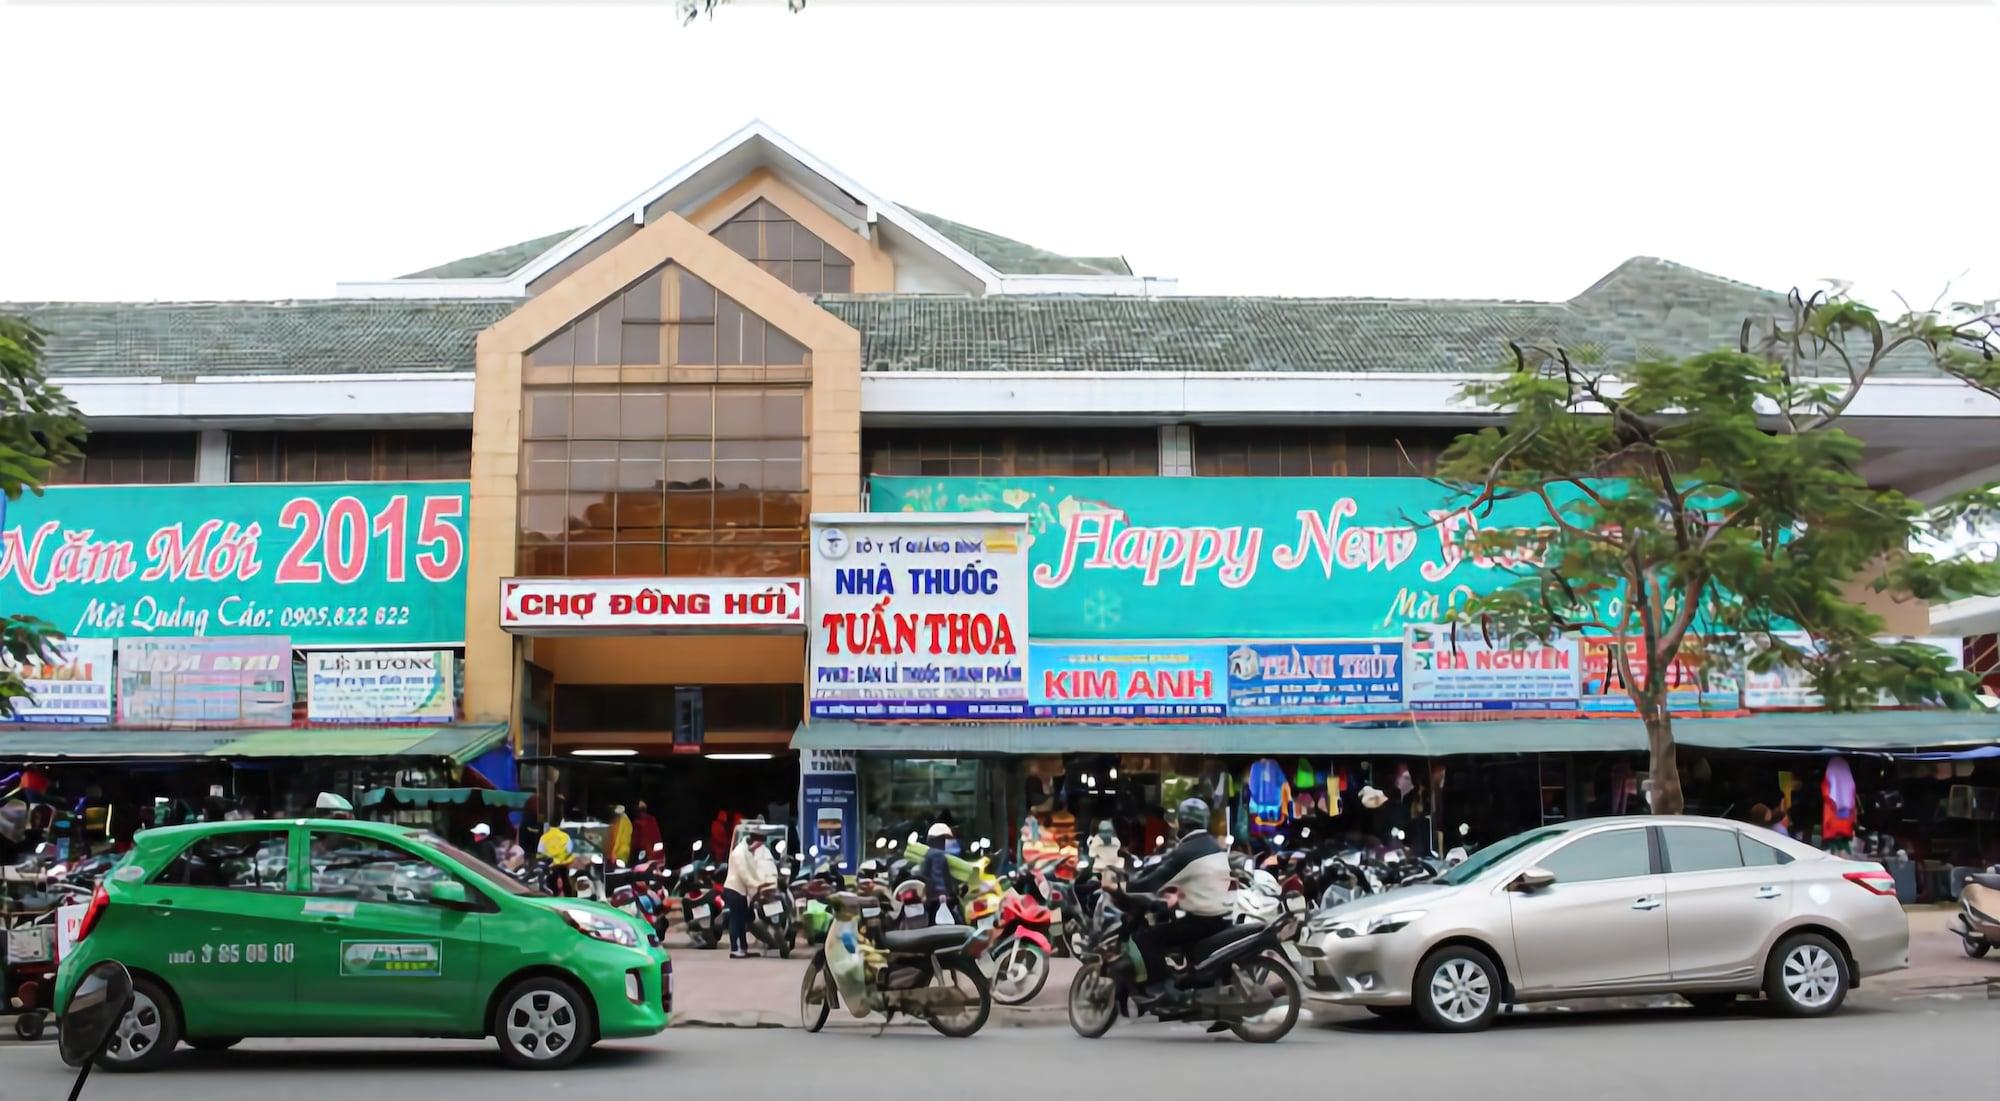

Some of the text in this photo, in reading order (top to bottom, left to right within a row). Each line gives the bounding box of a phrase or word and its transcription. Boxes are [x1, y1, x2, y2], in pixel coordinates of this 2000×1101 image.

[1, 495, 464, 595] Năm Mới 2015
[1033, 507, 1263, 588] Happy
[1272, 497, 1417, 580] New
[836, 559, 998, 595] NHÀ THUỐC
[520, 586, 787, 620] CHỢ ĐỒNG HỚI
[822, 596, 1017, 655] TUẤN THOA
[1044, 669, 1213, 700] KIM ANH
